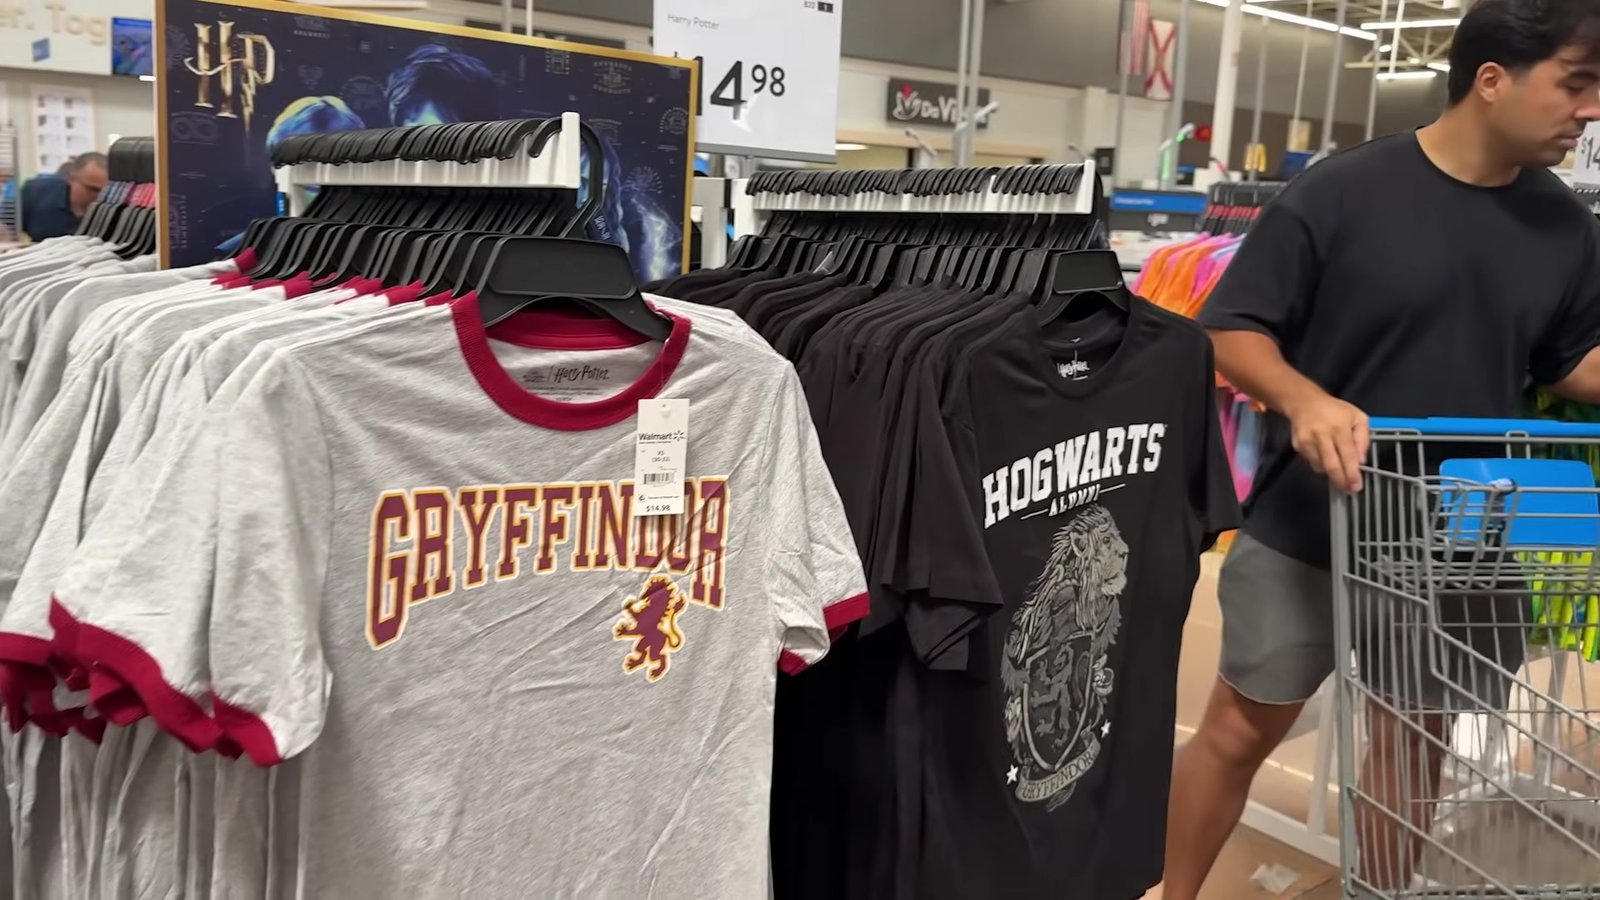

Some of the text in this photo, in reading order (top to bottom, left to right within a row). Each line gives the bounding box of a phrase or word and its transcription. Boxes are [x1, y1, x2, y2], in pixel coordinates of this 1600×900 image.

[694, 16, 720, 29] Potter
[982, 423, 1165, 529] HOGWARTS
[646, 504, 671, 513] $14.98
[1049, 484, 1100, 516] ALUMNI
[366, 476, 731, 649] GRYFFINDOR
[1022, 752, 1094, 799] GRYFFINDOR
